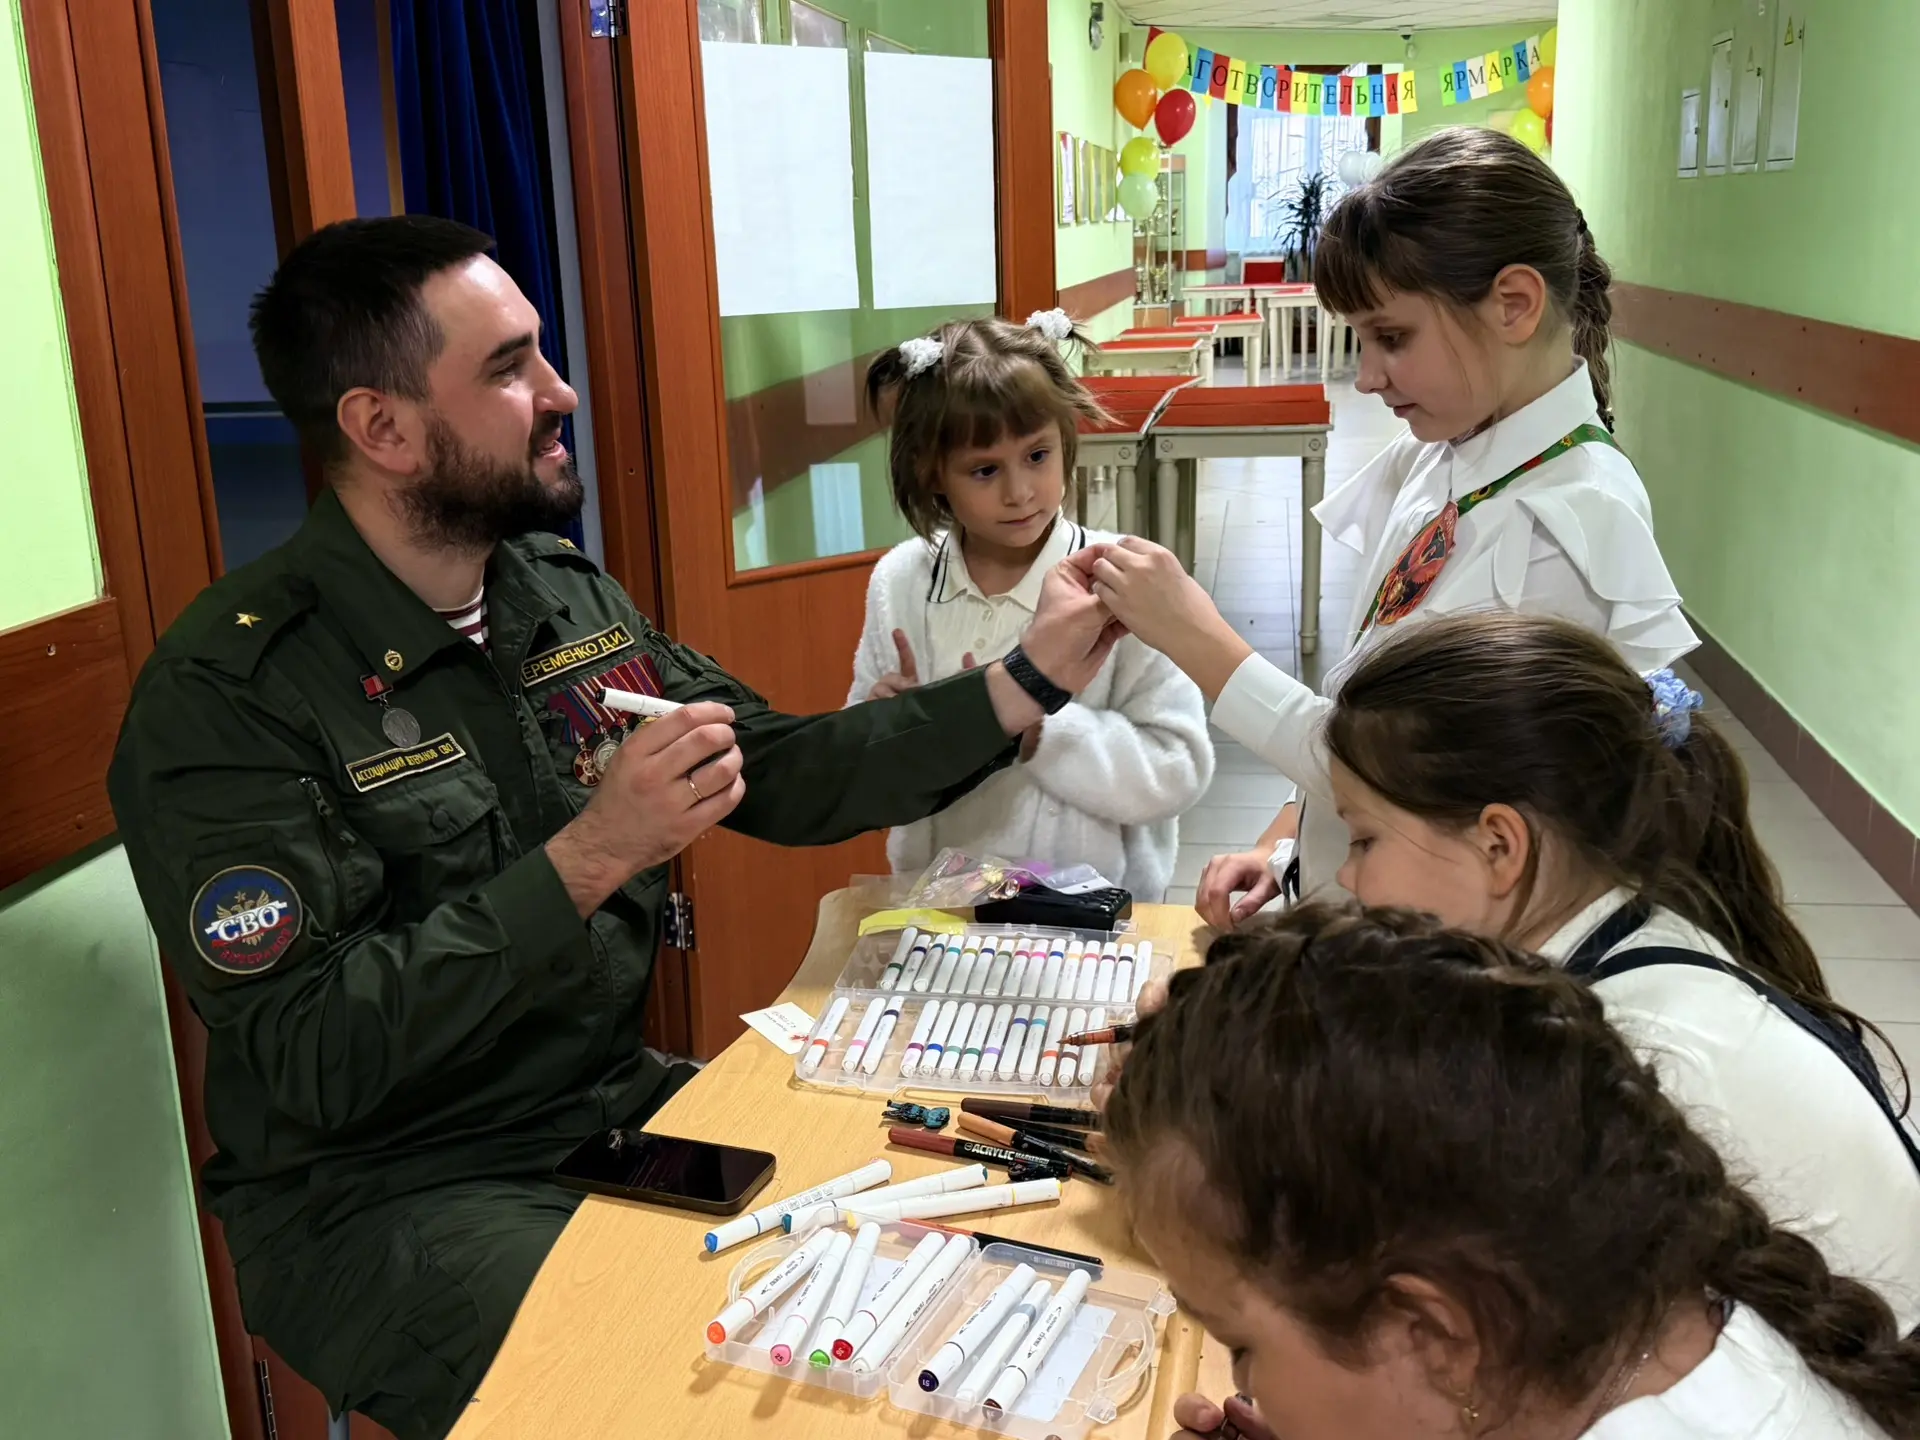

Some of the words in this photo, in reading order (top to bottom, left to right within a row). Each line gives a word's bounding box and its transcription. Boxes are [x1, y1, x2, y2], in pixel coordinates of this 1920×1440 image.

[1186, 53, 1415, 105] АГОТВОРИТЕЛЬНАЯ
[1443, 45, 1541, 93] ЯРМАРКА
[521, 642, 598, 681] ЕРЕМЕНКО
[598, 631, 628, 653] Д.И.
[355, 756, 407, 784] АССОЦИАЦИЯ
[438, 743, 455, 755] СВО
[217, 905, 281, 942] СВО
[972, 1143, 1015, 1161] ACRYLIC
[774, 1352, 785, 1362] 25
[922, 1378, 931, 1387] 51
